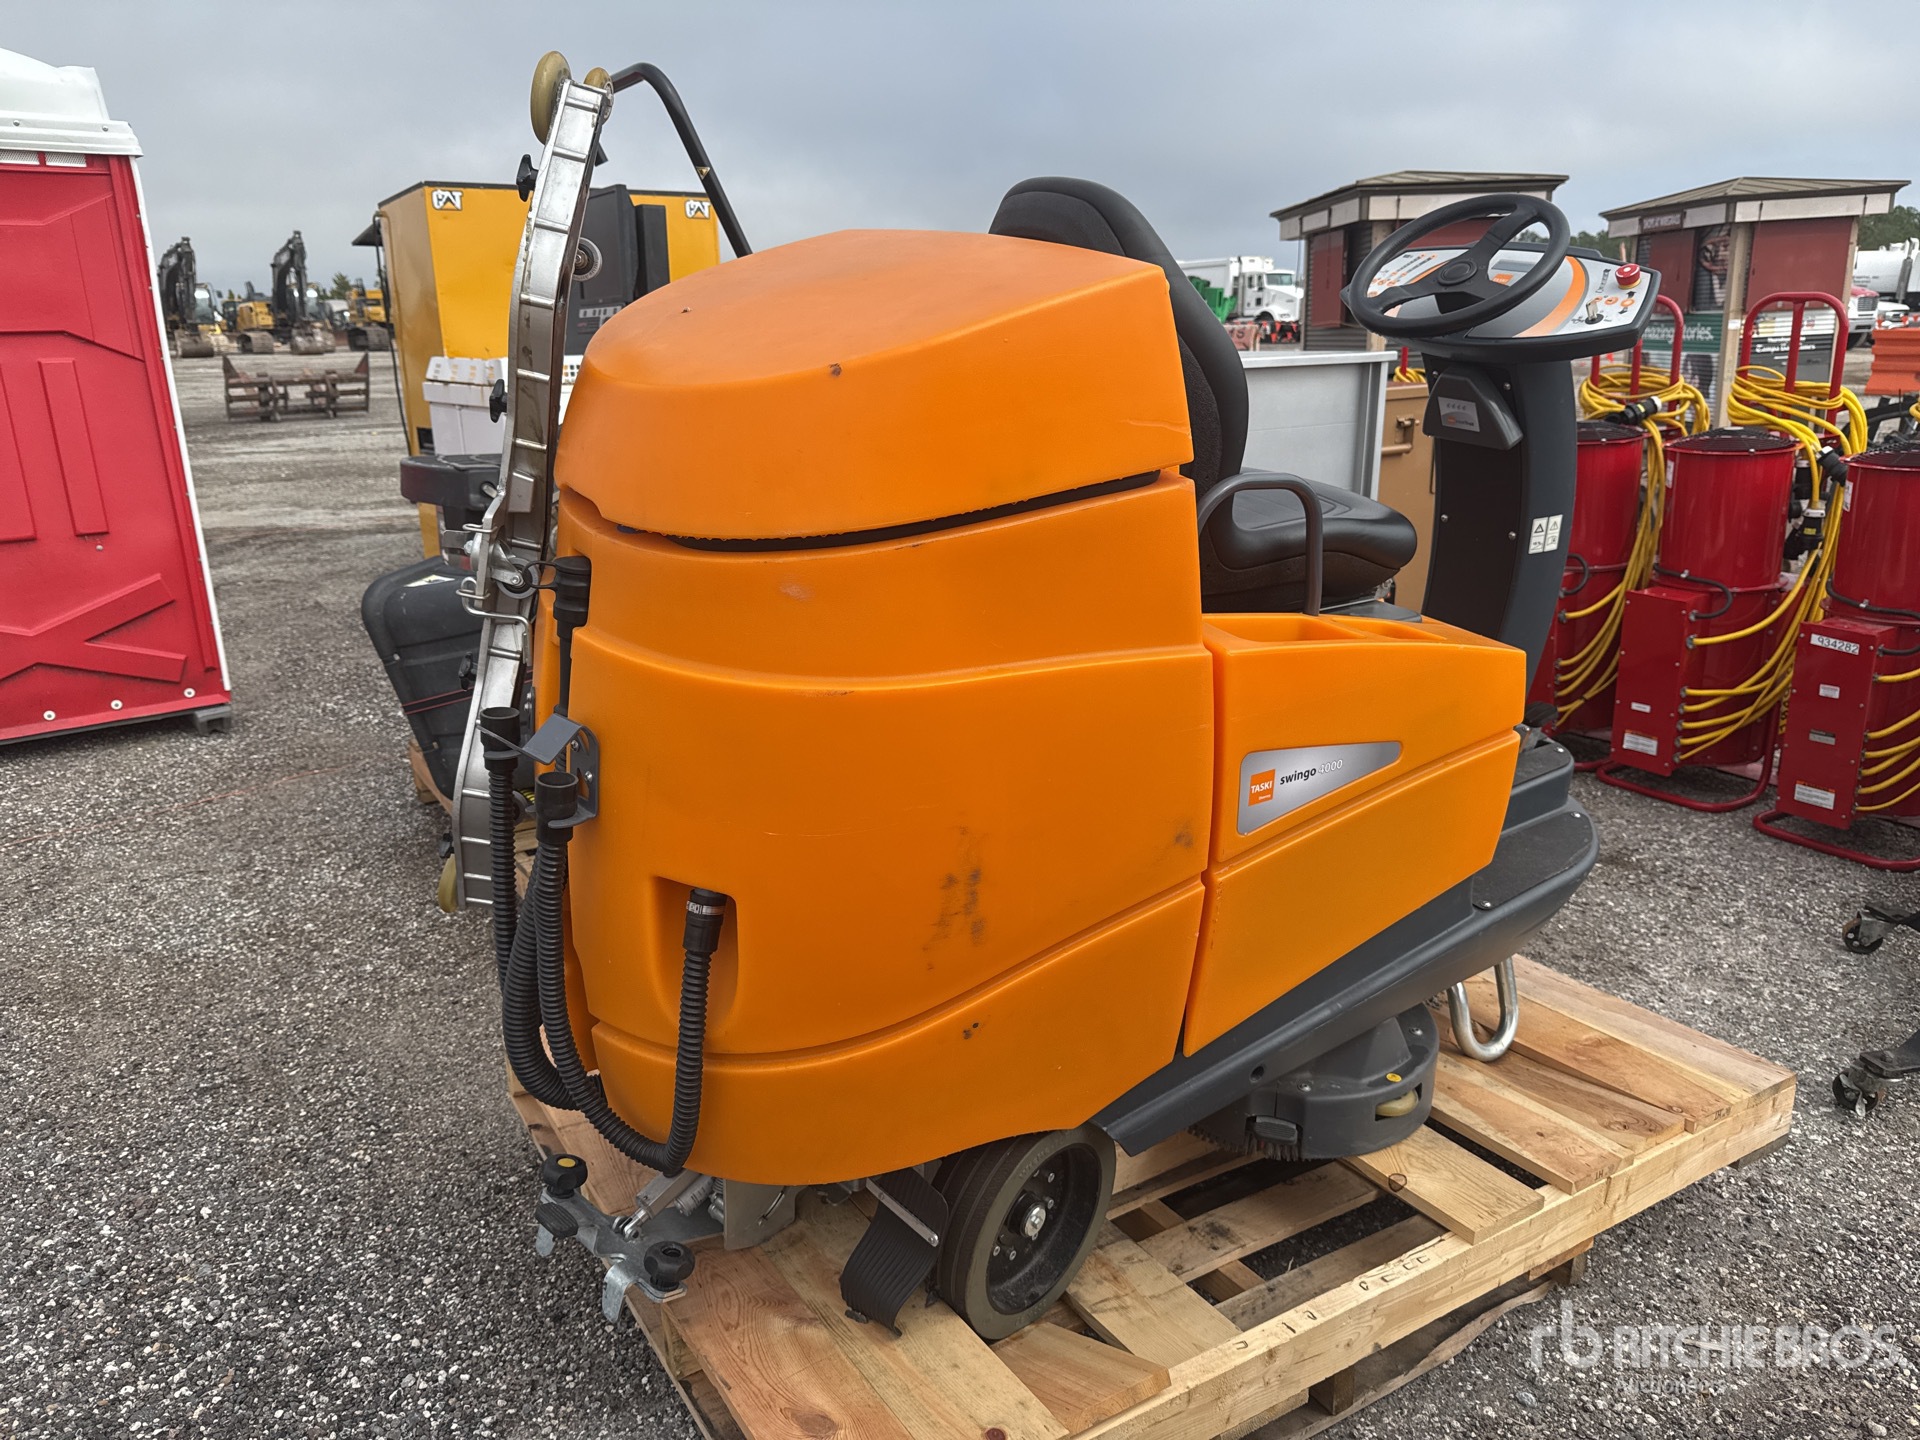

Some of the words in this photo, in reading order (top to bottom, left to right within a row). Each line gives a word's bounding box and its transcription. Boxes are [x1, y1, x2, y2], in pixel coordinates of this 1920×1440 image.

[432, 189, 463, 211] CAT
[685, 199, 711, 219] CAT
[1817, 635, 1860, 655] 934282
[1279, 767, 1317, 786] swingo
[1318, 759, 1344, 775] 4000
[1250, 780, 1273, 795] TASKI
